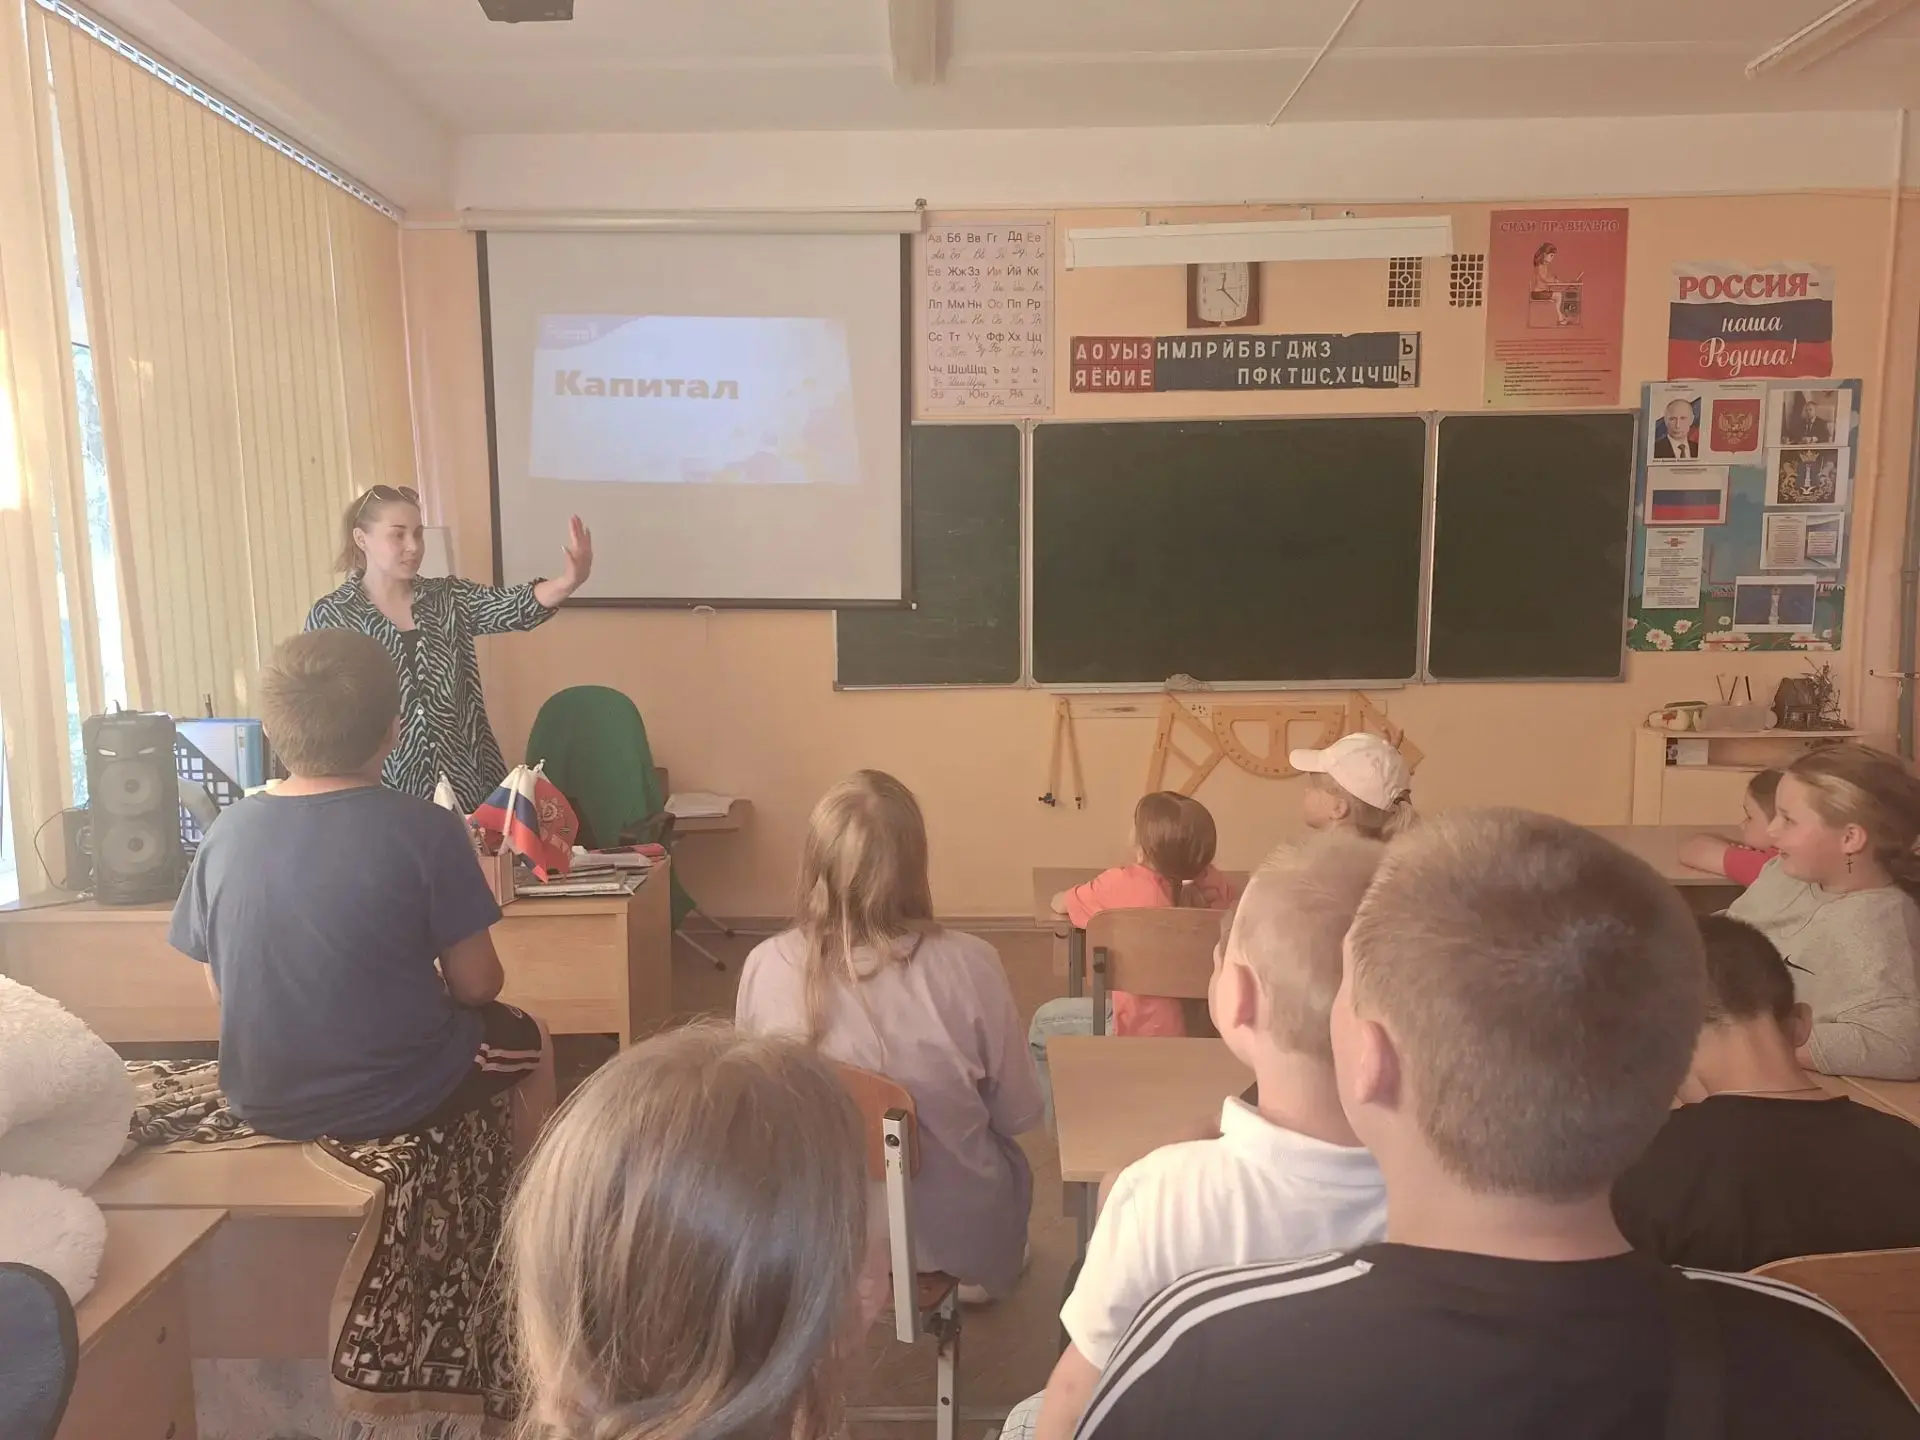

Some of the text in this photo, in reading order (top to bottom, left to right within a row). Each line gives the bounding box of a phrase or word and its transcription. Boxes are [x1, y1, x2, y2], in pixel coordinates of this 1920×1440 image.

[1501, 219, 1620, 232] СИДИ ПРАВИЛЬНО
[1721, 316, 1783, 333] наша
[1700, 337, 1797, 377] Родина!
[554, 369, 739, 400] Капитал
